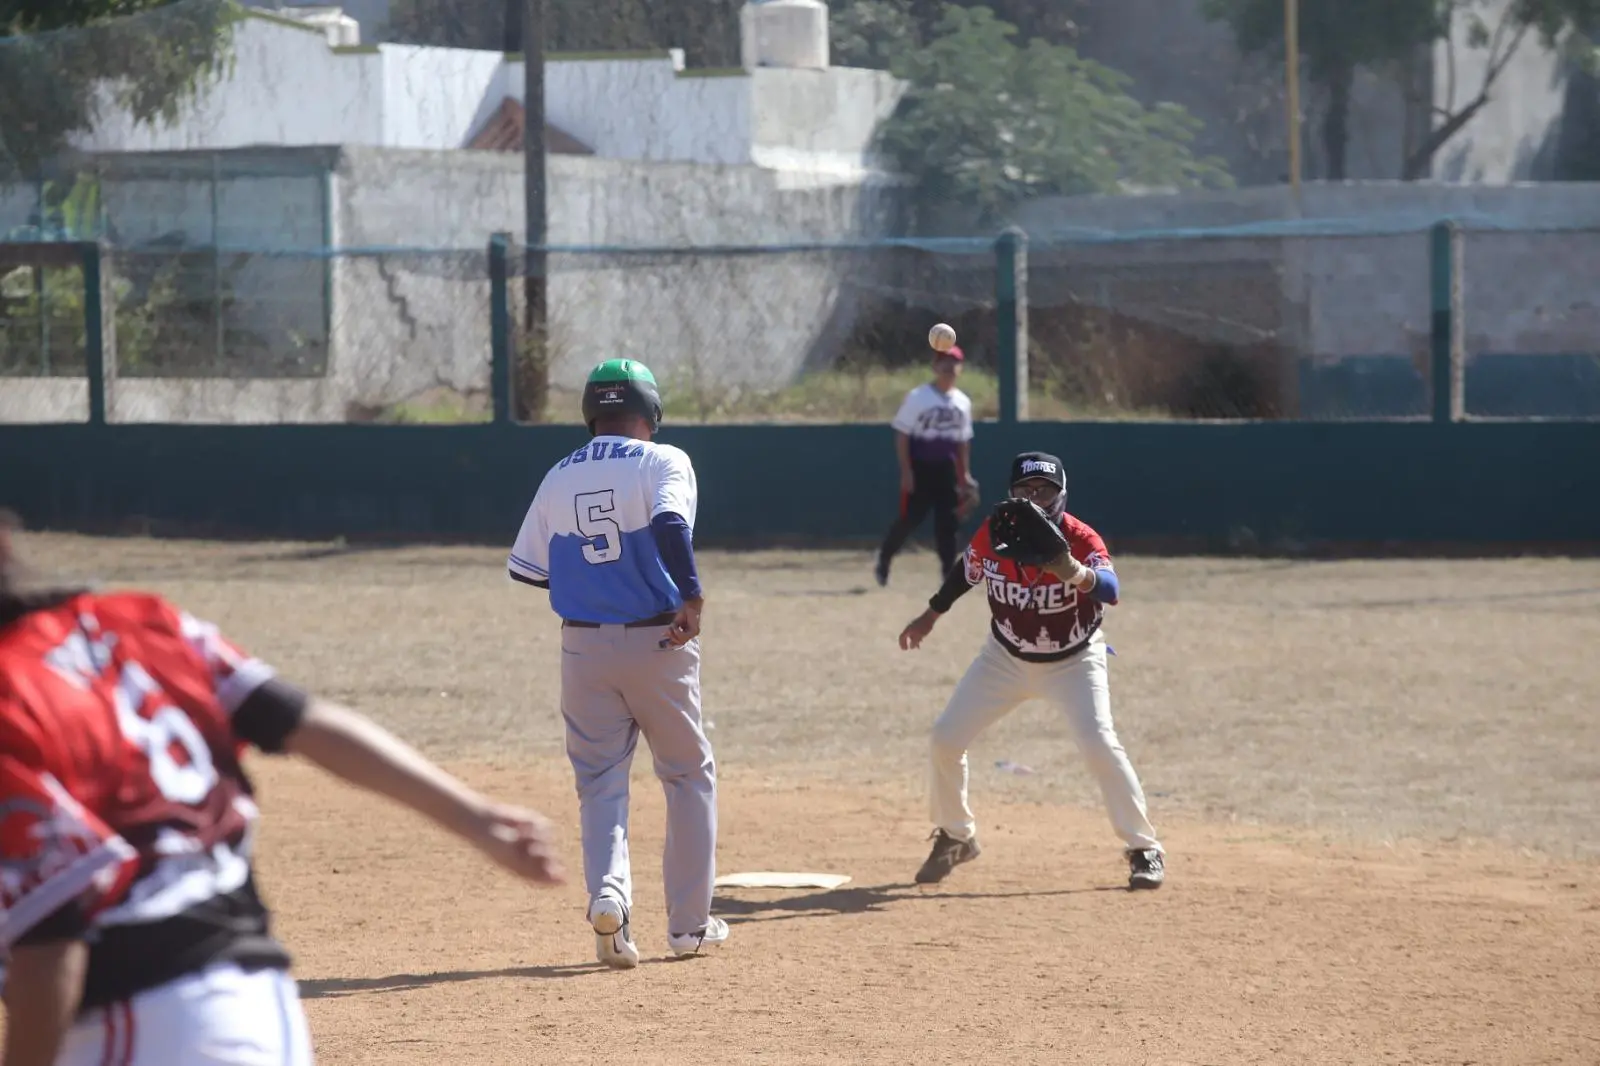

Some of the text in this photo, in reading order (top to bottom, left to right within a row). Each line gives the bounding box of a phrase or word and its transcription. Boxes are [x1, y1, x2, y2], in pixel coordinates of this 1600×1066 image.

[1020, 459, 1057, 474] TORRES
[575, 489, 622, 565] 5
[982, 568, 1078, 614] TORRES
